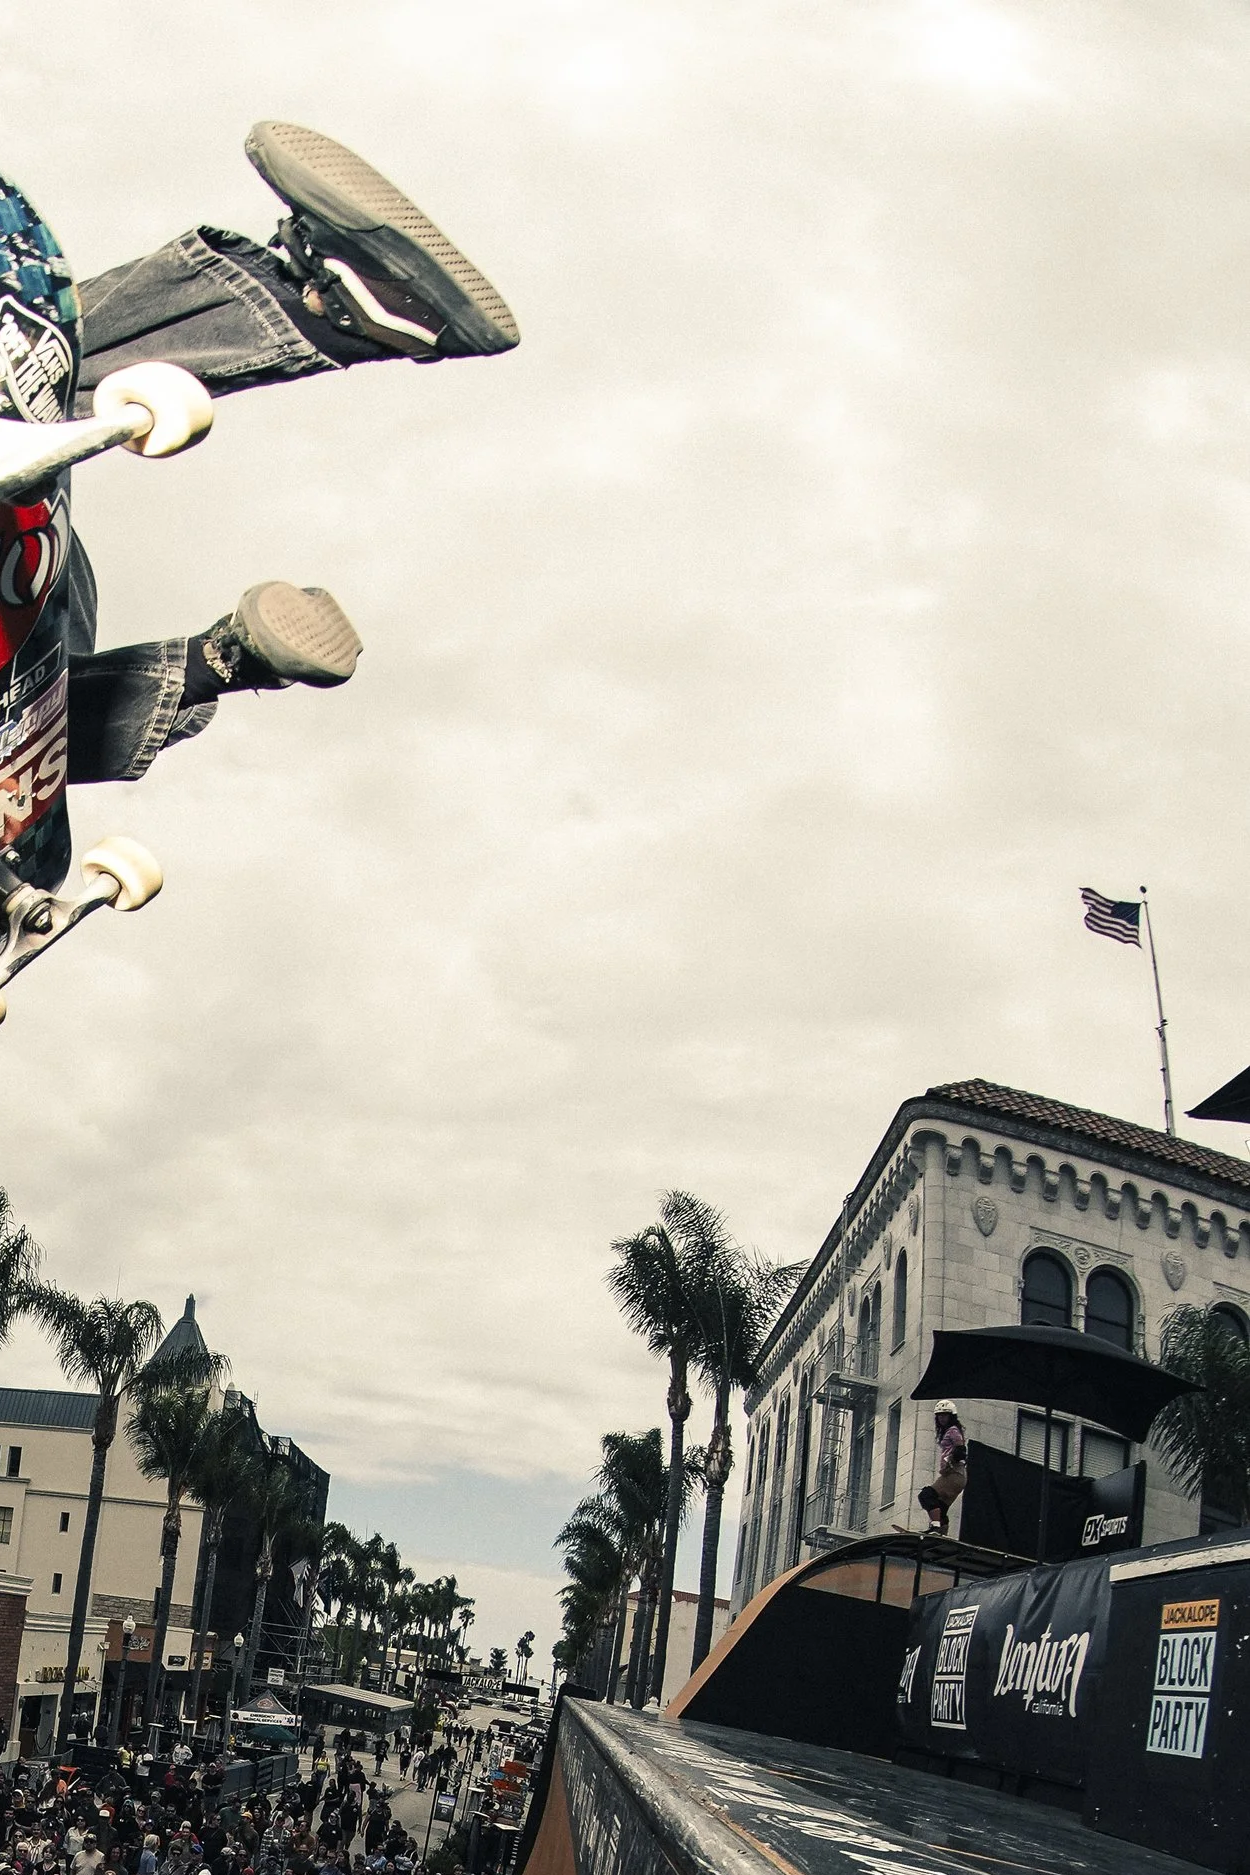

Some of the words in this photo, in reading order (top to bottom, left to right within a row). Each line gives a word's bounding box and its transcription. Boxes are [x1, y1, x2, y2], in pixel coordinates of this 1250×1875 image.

[34, 328, 70, 385] VANS
[14, 350, 49, 404] THE
[1100, 1516, 1128, 1536] SPORTS
[1163, 1604, 1217, 1624] JACKALOPE
[937, 1635, 969, 1674] BLOCK
[1156, 1636, 1214, 1688] BLOCK
[463, 1677, 501, 1689] JACKALOPE
[932, 1682, 963, 1722] PARTY
[1031, 1699, 1064, 1716] california
[1149, 1699, 1207, 1754] PARTY
